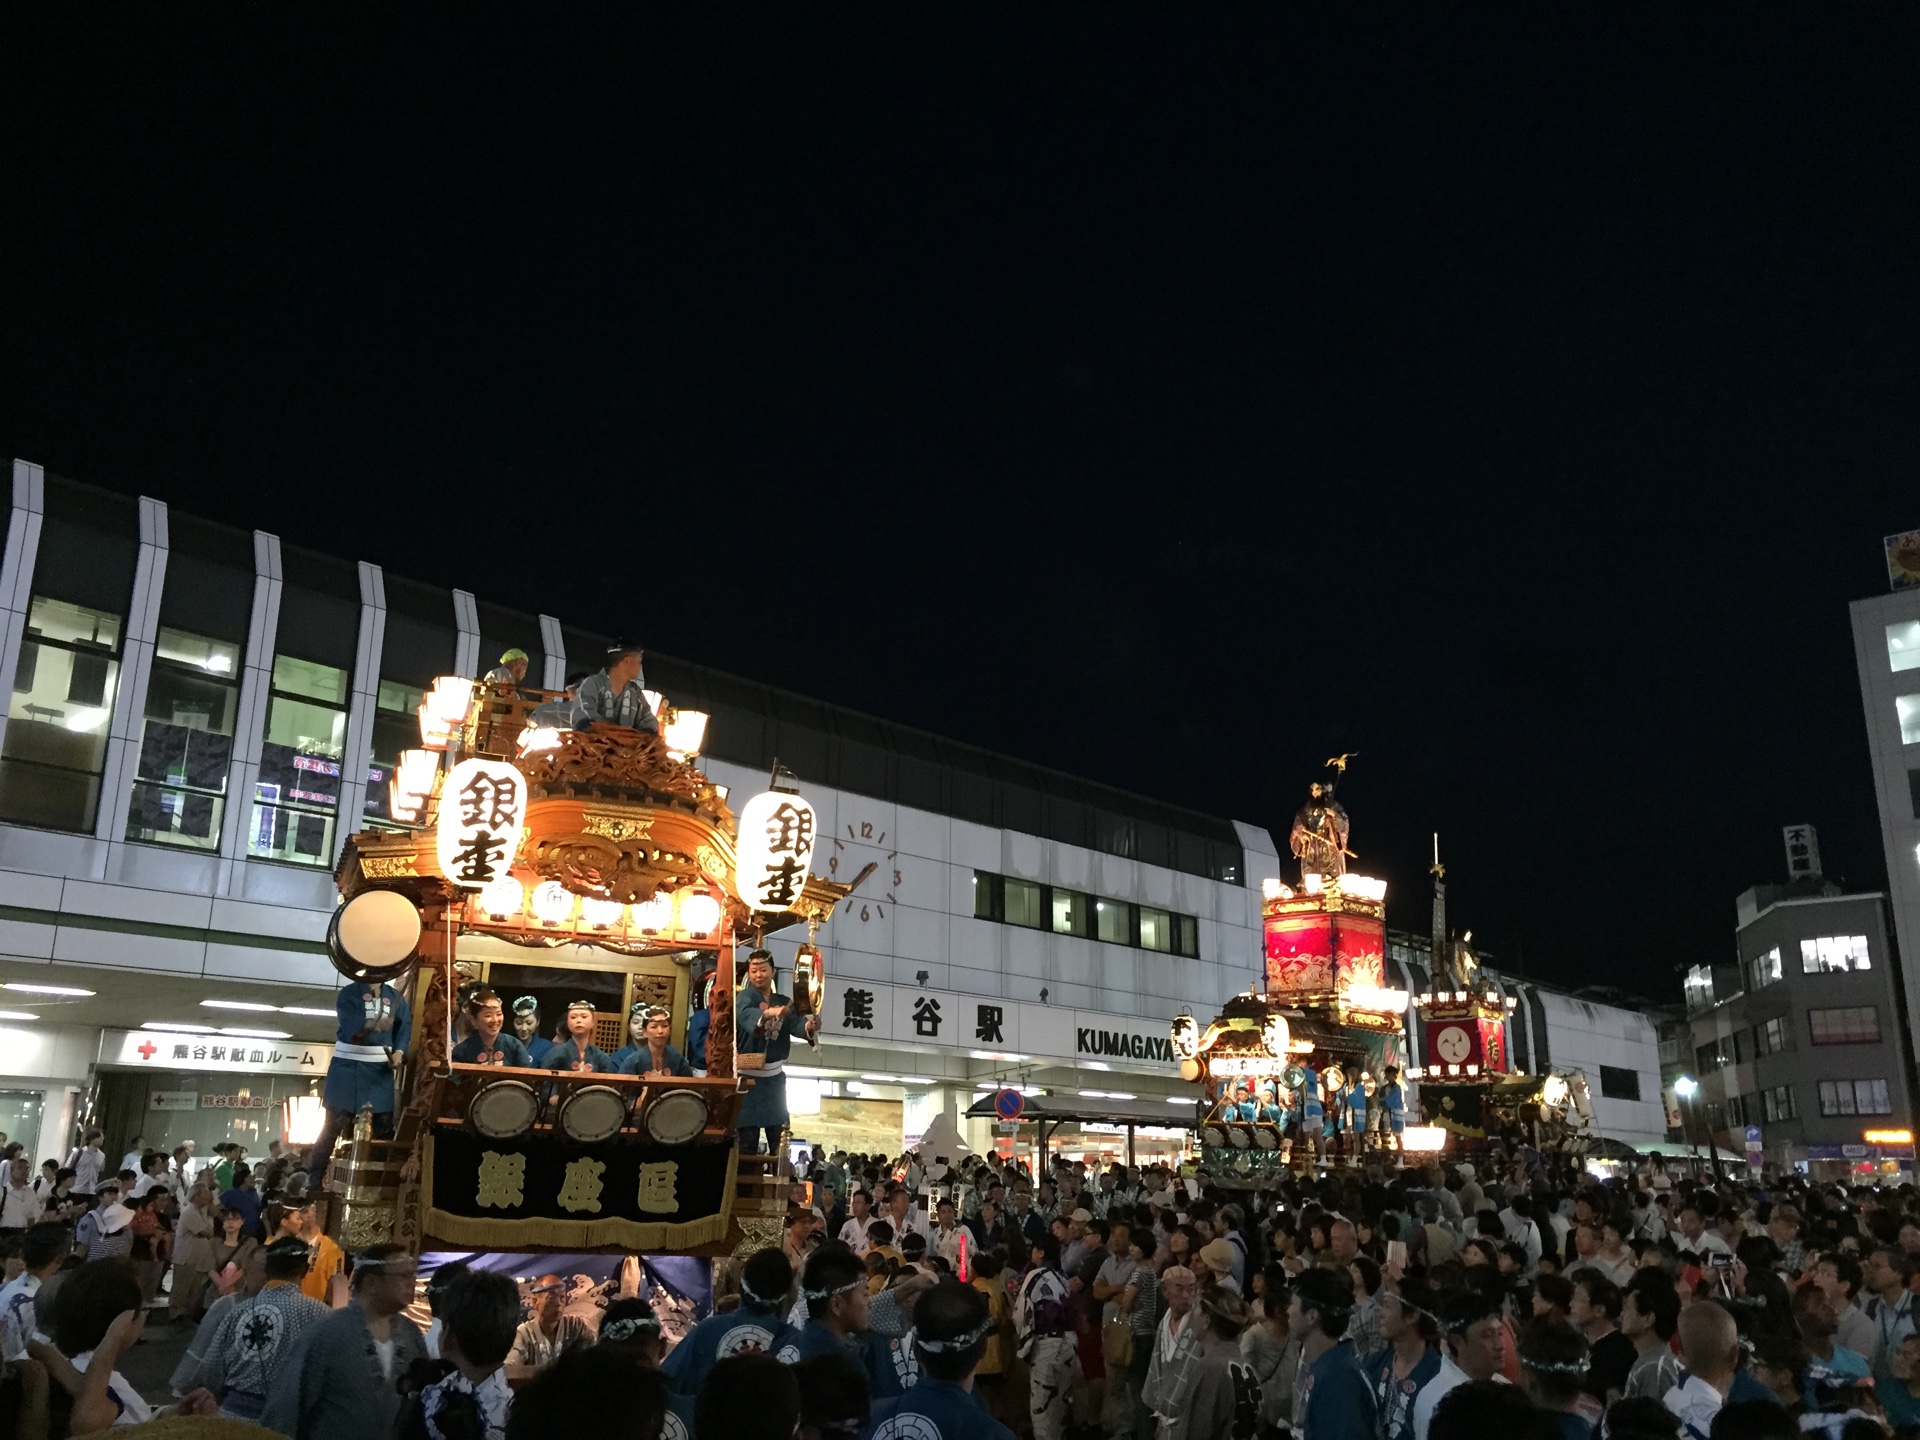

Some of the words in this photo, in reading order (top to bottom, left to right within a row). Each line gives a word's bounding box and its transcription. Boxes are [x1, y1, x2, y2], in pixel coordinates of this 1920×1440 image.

[861, 821, 873, 839] 12
[829, 856, 838, 874] 9
[893, 869, 902, 886] 3
[860, 904, 869, 922] 6
[842, 987, 1004, 1043] 熊谷駅
[1077, 1027, 1175, 1063] KUMAGAYA
[172, 1044, 315, 1066] 熊谷駅献血ルーム
